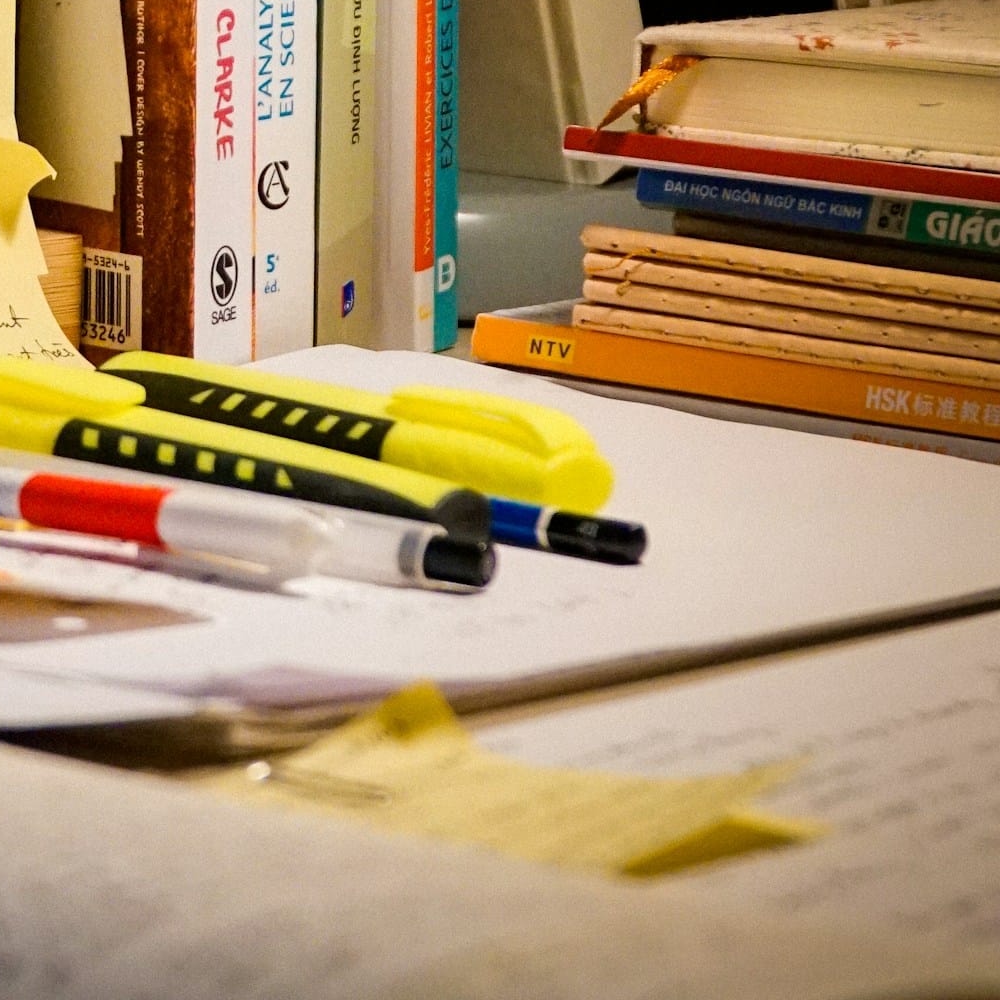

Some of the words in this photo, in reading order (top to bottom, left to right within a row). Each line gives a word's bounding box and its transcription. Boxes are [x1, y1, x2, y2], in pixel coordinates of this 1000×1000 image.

[136, 1, 146, 45] AUTHOR
[136, 58, 145, 92] COVER
[214, 8, 236, 161] CLARKE
[278, 77, 295, 118] EN
[439, 20, 454, 169] EXERCICES
[135, 96, 145, 136] DESIGN
[136, 140, 145, 155] BY
[135, 159, 145, 198] WENDY
[135, 203, 145, 239] SCOTT
[829, 203, 863, 220] KINH
[264, 279, 280, 294] éd.
[211, 305, 237, 325] SAGE
[528, 337, 572, 360] NTV
